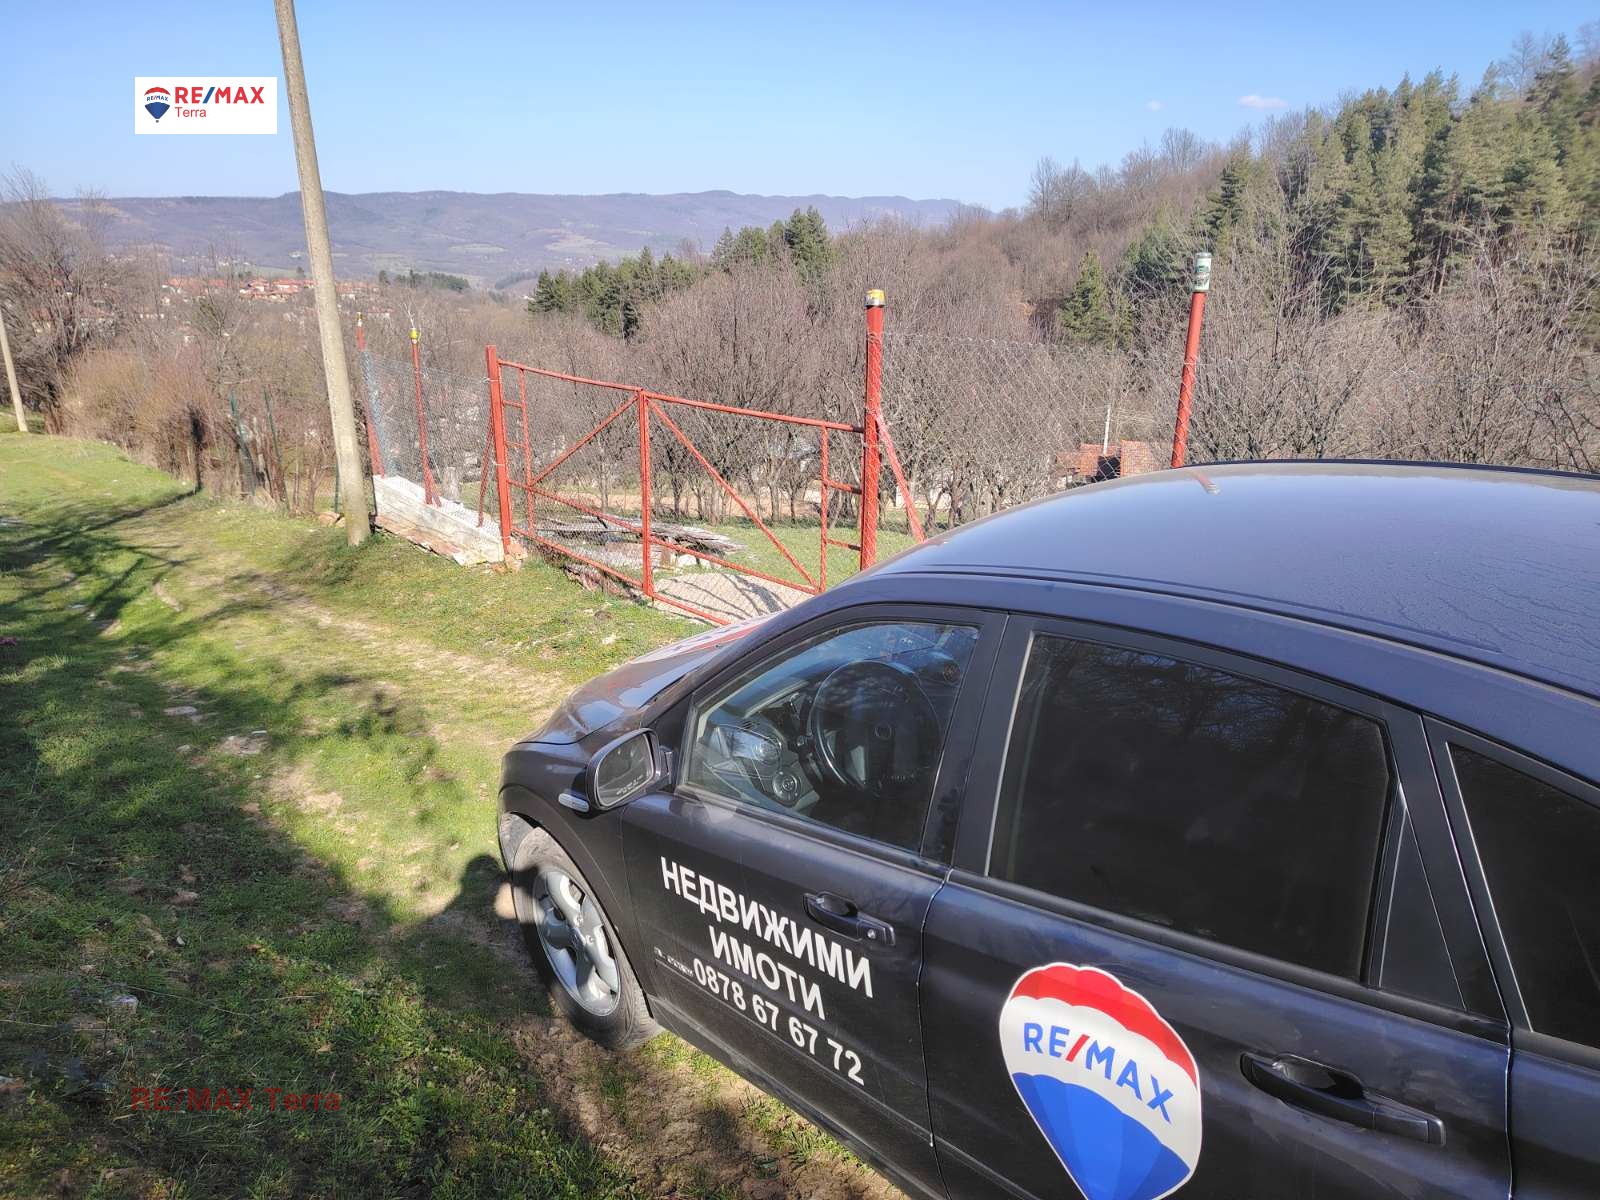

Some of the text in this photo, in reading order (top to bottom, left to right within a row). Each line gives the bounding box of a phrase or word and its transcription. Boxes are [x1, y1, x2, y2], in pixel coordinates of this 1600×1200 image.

[660, 856, 873, 998] НЕДВИЖИМИ
[708, 925, 826, 1021] ИМОТИ
[693, 958, 747, 1011] 0878
[752, 994, 780, 1031] 67
[788, 1016, 819, 1055] 67
[827, 1038, 865, 1087] 72
[1023, 1022, 1174, 1124] RE/MAX
